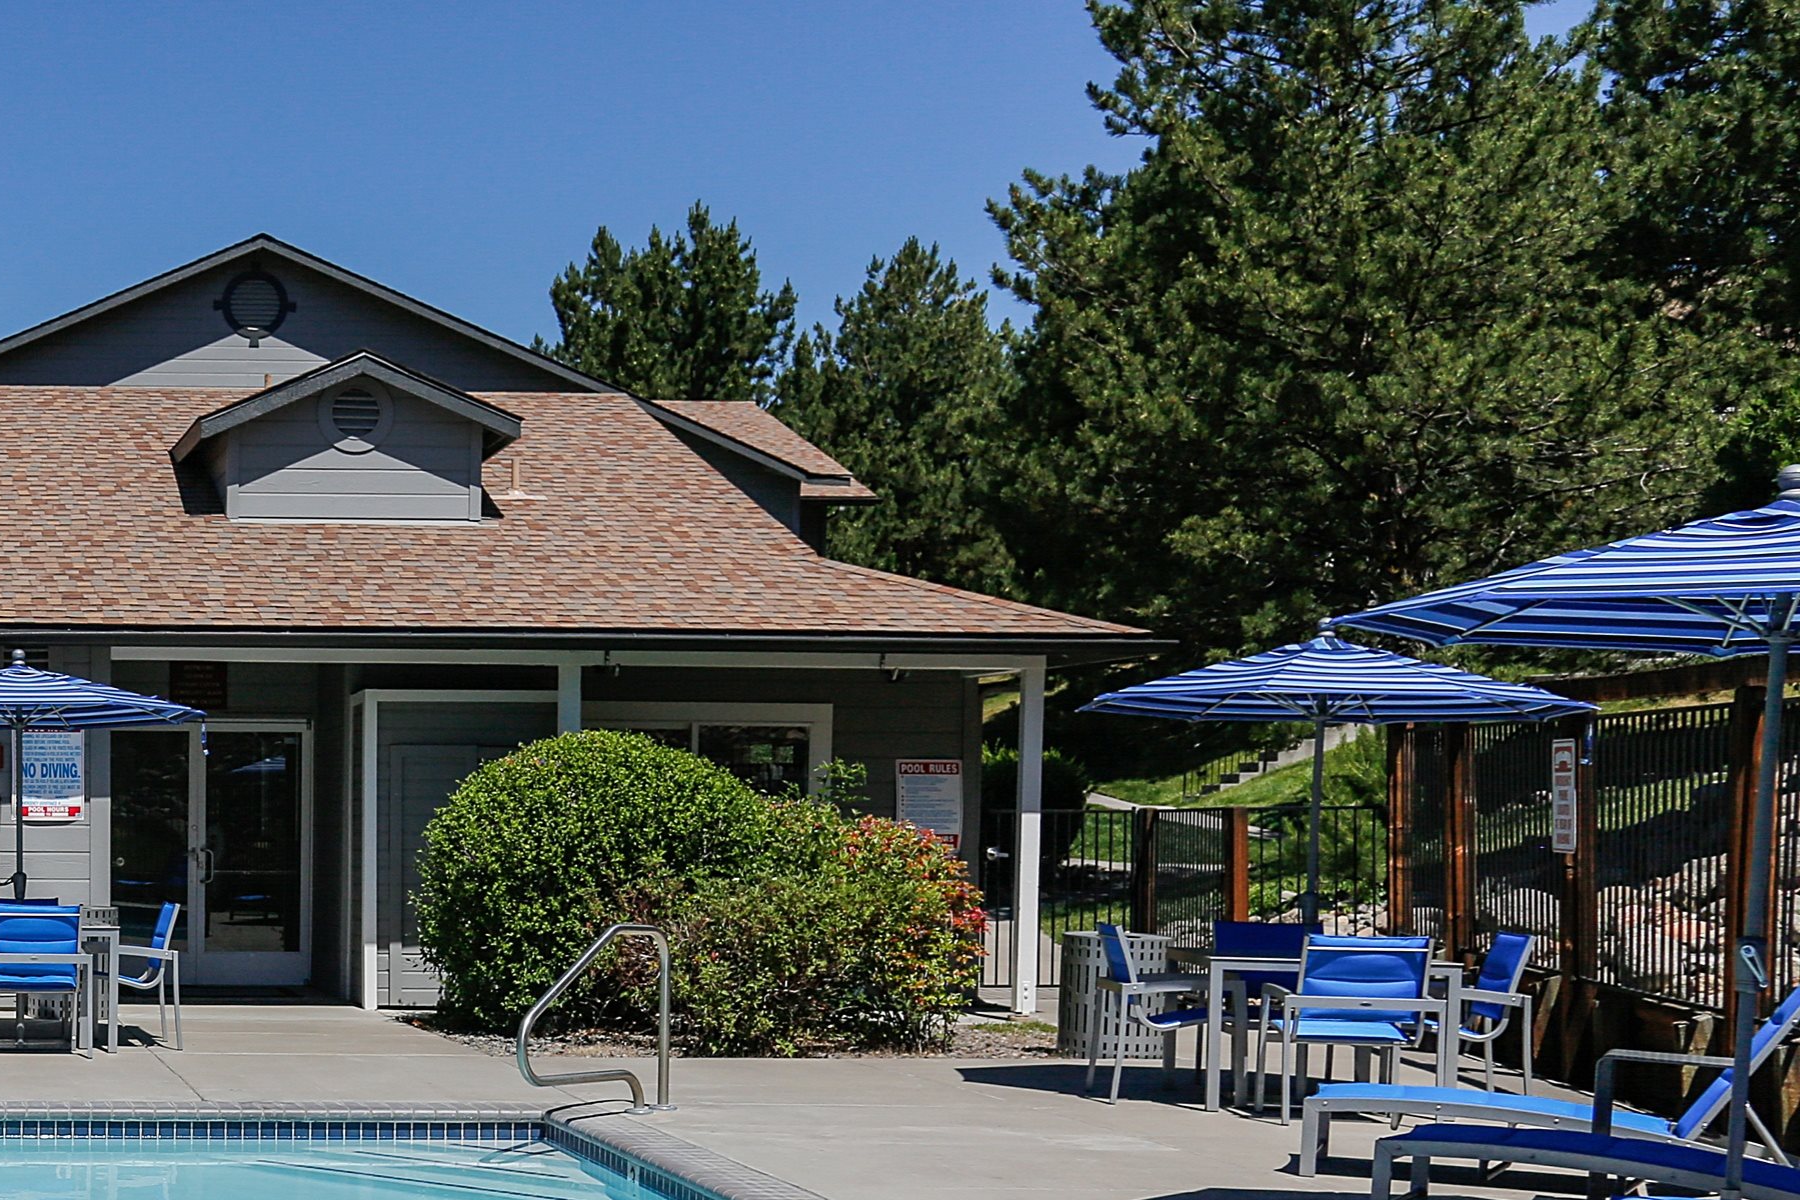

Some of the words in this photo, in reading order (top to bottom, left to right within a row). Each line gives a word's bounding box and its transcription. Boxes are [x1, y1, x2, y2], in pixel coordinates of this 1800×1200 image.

[23, 763, 36, 778] NO
[41, 763, 81, 778] DIVING.
[901, 764, 925, 773] POOL
[929, 764, 958, 773] RULES
